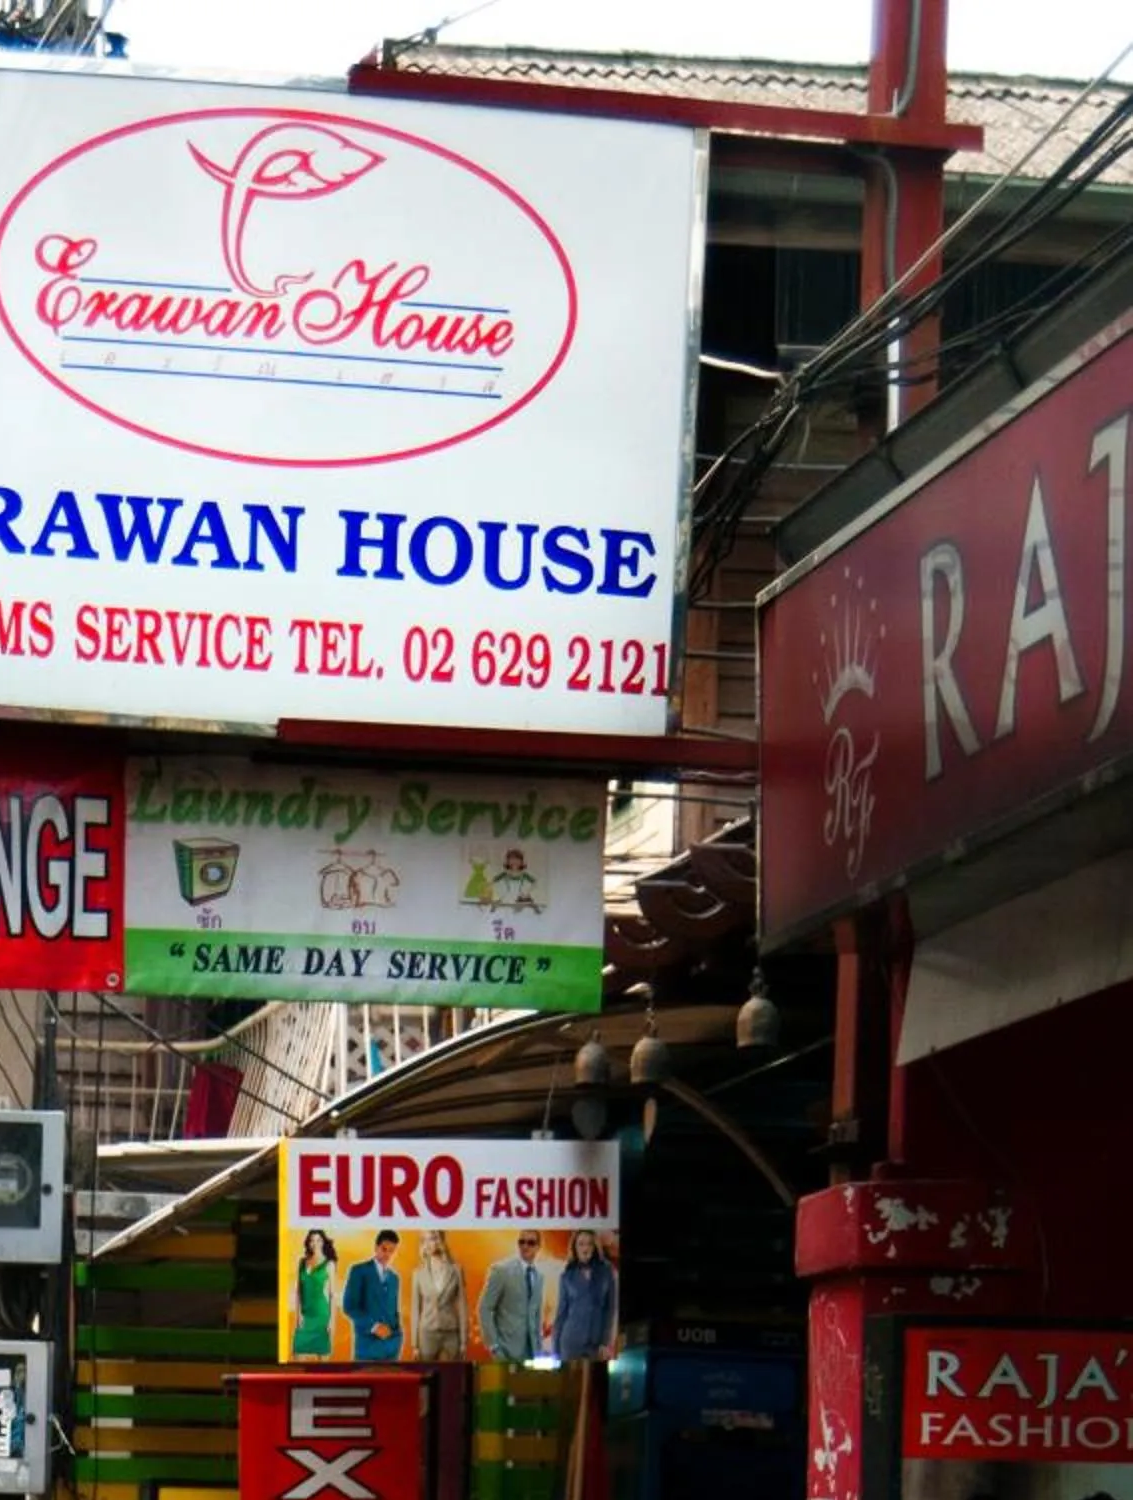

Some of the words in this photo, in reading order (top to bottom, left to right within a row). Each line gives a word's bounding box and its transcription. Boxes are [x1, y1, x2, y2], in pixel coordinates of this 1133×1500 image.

[34, 233, 293, 340] Erawan
[293, 258, 516, 359] House
[338, 509, 658, 599] HOUSE
[75, 606, 273, 675] SERVICE
[290, 619, 385, 682] TEL.
[402, 628, 455, 685] 02
[469, 632, 552, 692] 629
[567, 640, 670, 698] 2121
[132, 765, 372, 846] Laundry
[389, 781, 602, 846] Service
[304, 949, 372, 978] DAY
[298, 1154, 464, 1220] EURO
[474, 1177, 610, 1220] FASHION
[925, 1348, 1133, 1410] RAJA'
